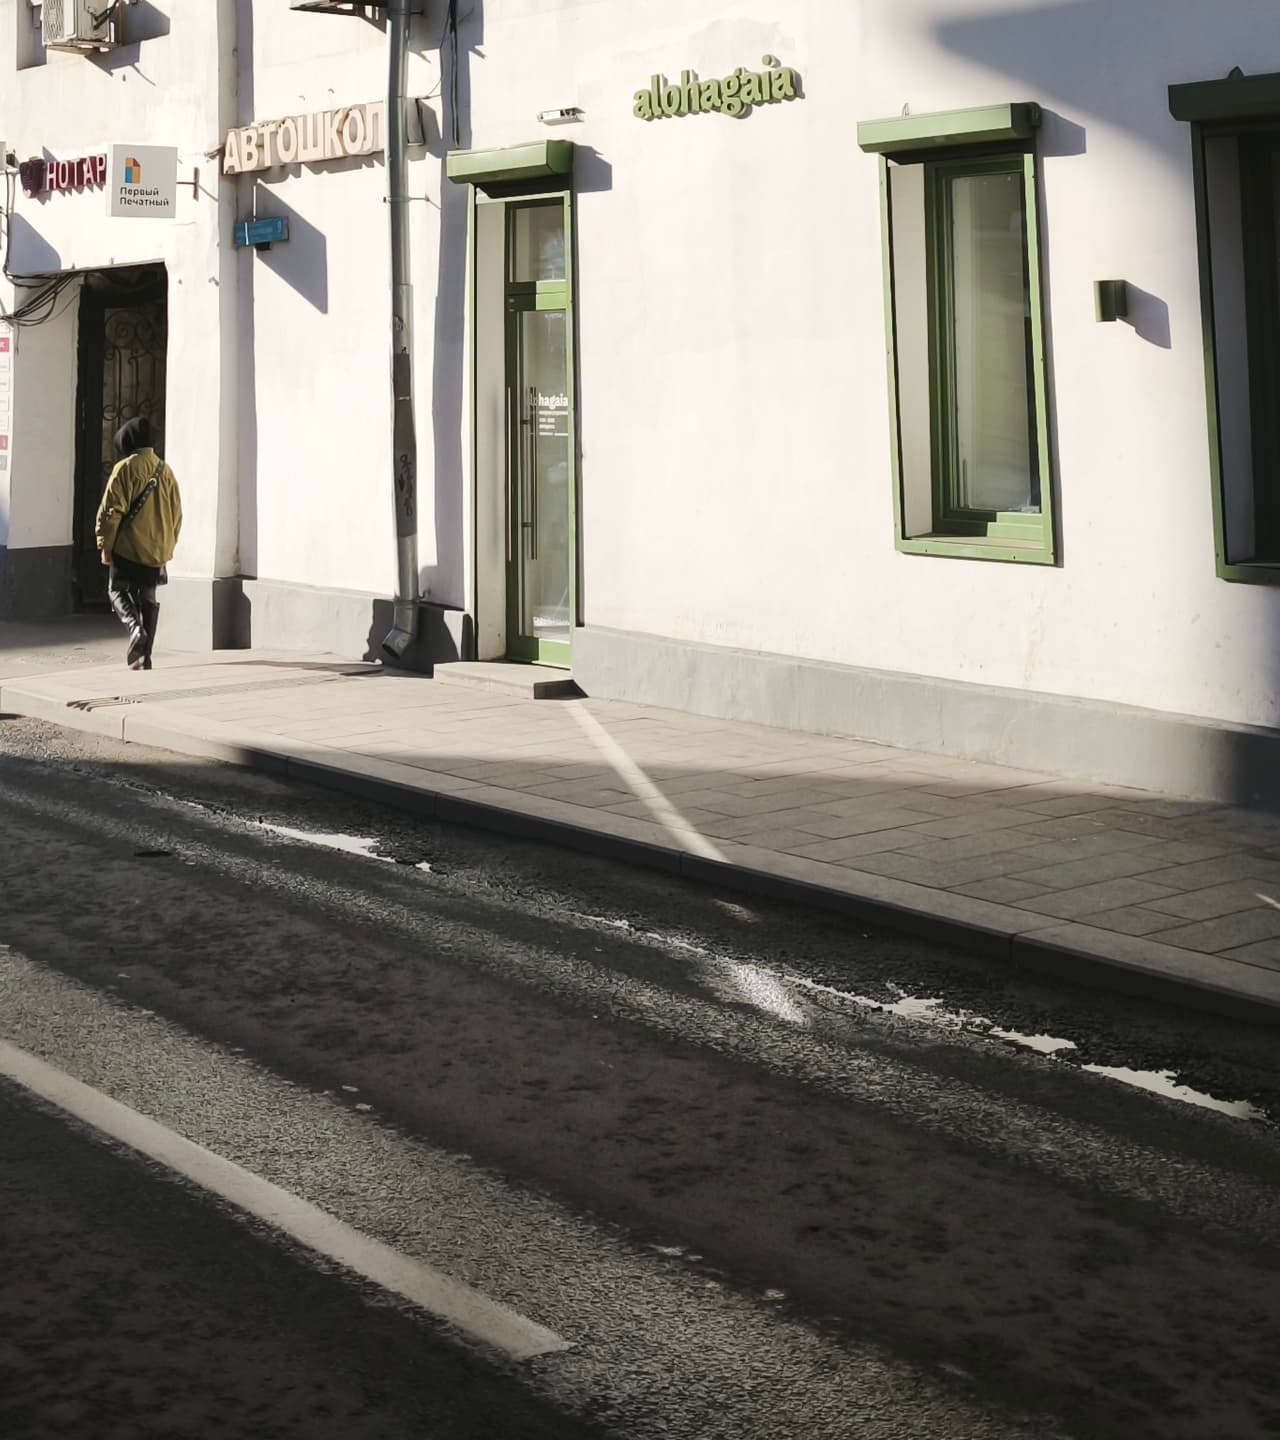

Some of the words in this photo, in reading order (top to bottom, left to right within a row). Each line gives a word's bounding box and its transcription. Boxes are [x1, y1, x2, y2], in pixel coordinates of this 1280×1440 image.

[633, 54, 797, 120] alohagaia
[223, 103, 386, 174] АВТОШКОЛ
[46, 154, 107, 191] НОТАР
[120, 187, 159, 197] Первый
[120, 197, 169, 207] Печатный
[531, 392, 568, 409] hagaia
